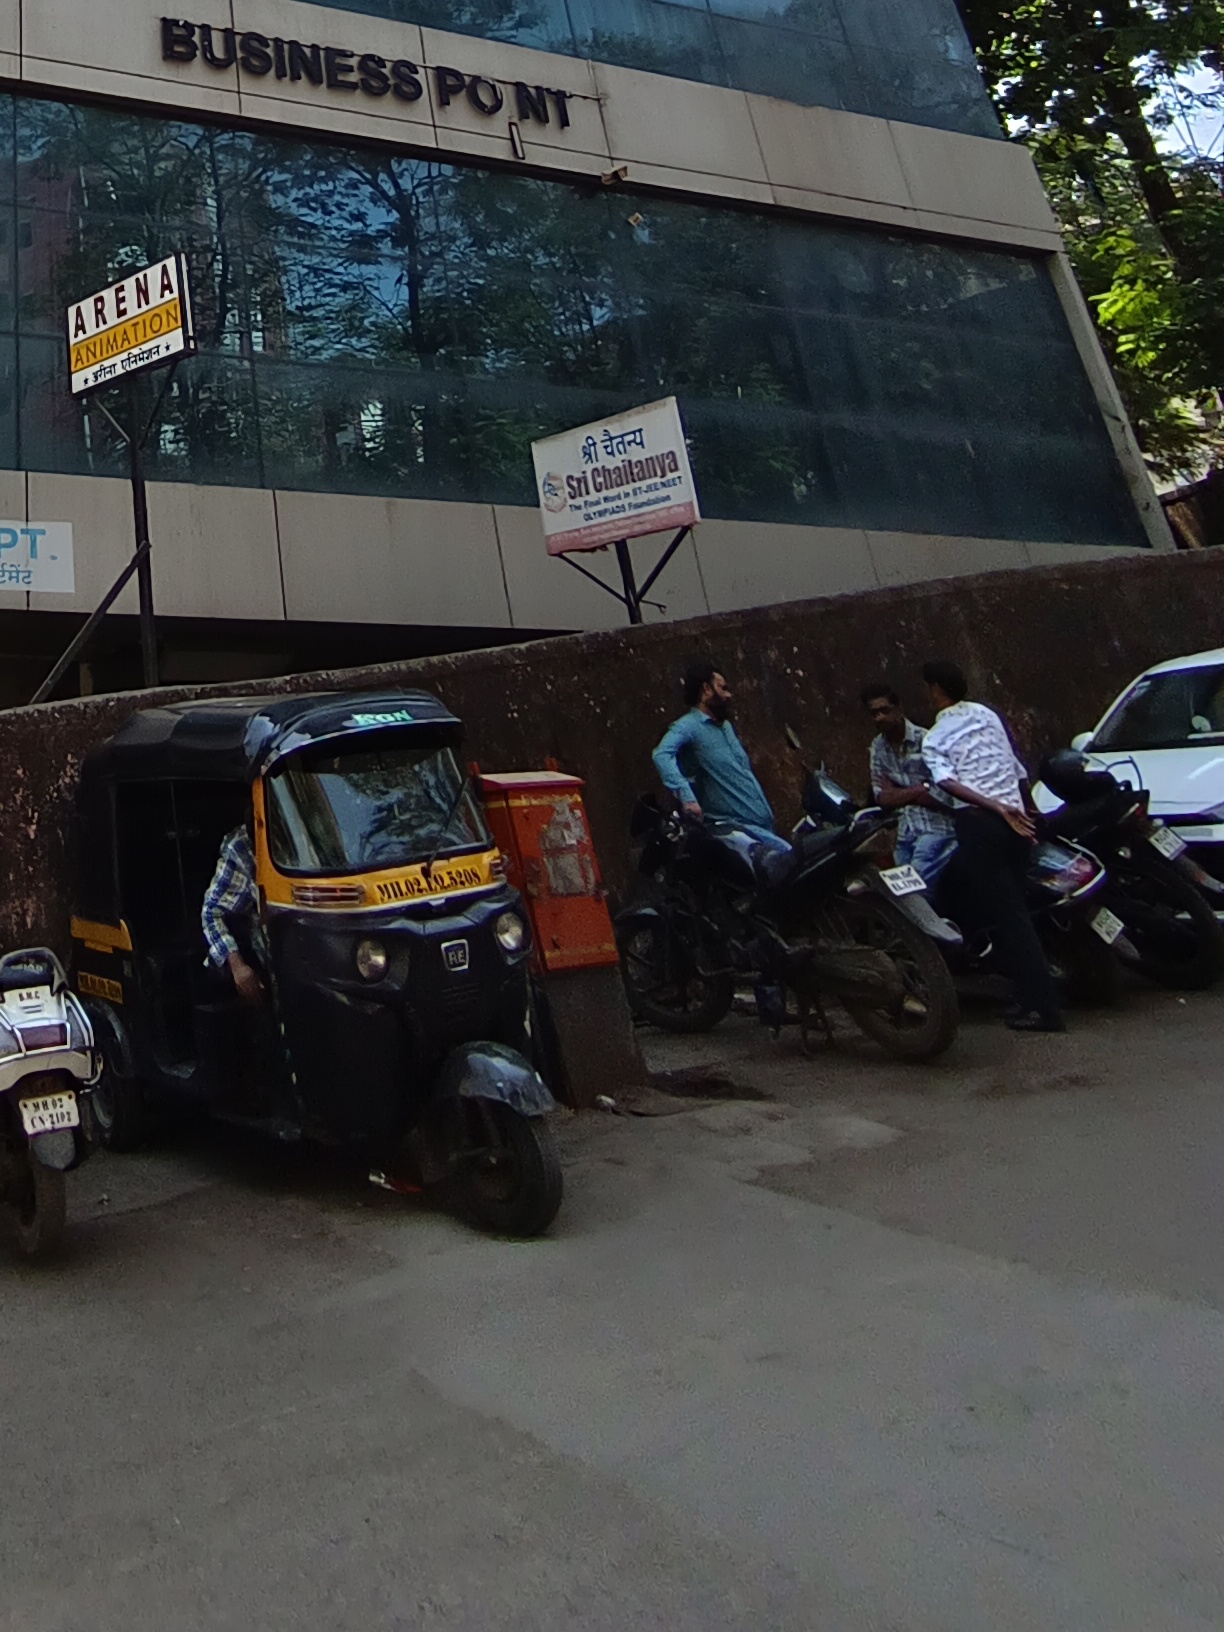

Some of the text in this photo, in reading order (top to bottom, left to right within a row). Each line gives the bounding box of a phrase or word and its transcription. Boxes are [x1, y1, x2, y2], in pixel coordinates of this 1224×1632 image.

[160, 17, 424, 102] BUSINESS
[74, 263, 174, 339] ARENA
[74, 303, 179, 368] ANIMATION
[565, 449, 680, 500] Sri Chaitanya
[581, 428, 646, 465] श्री चैतन्य
